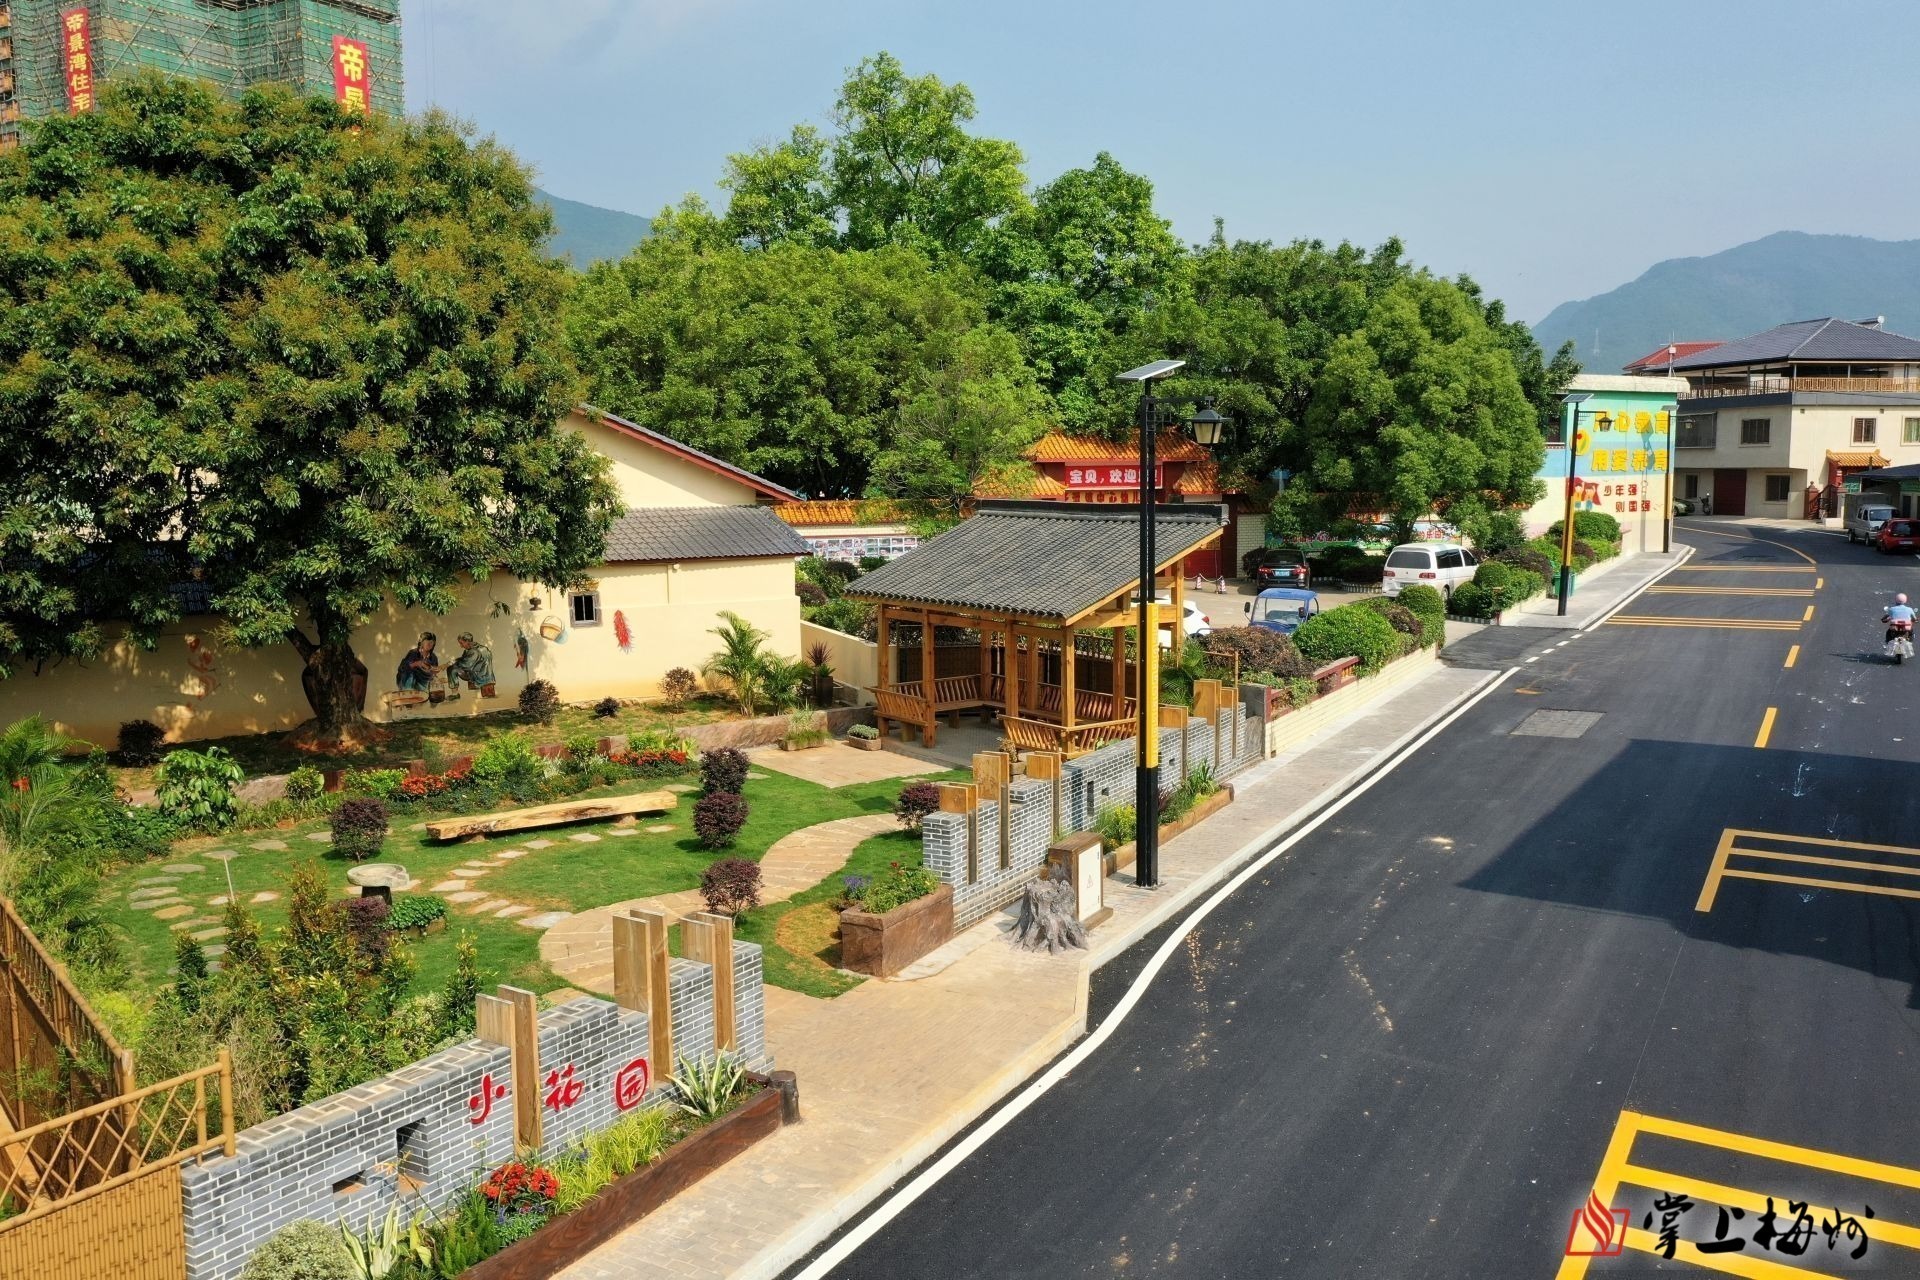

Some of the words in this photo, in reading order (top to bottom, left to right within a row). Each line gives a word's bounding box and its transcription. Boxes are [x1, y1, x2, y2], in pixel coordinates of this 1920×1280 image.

[66, 13, 91, 111] 帝景湾住宅
[1604, 484, 1637, 496] 少年强
[1615, 500, 1651, 512] 则国强
[469, 1058, 649, 1124] 小花园
